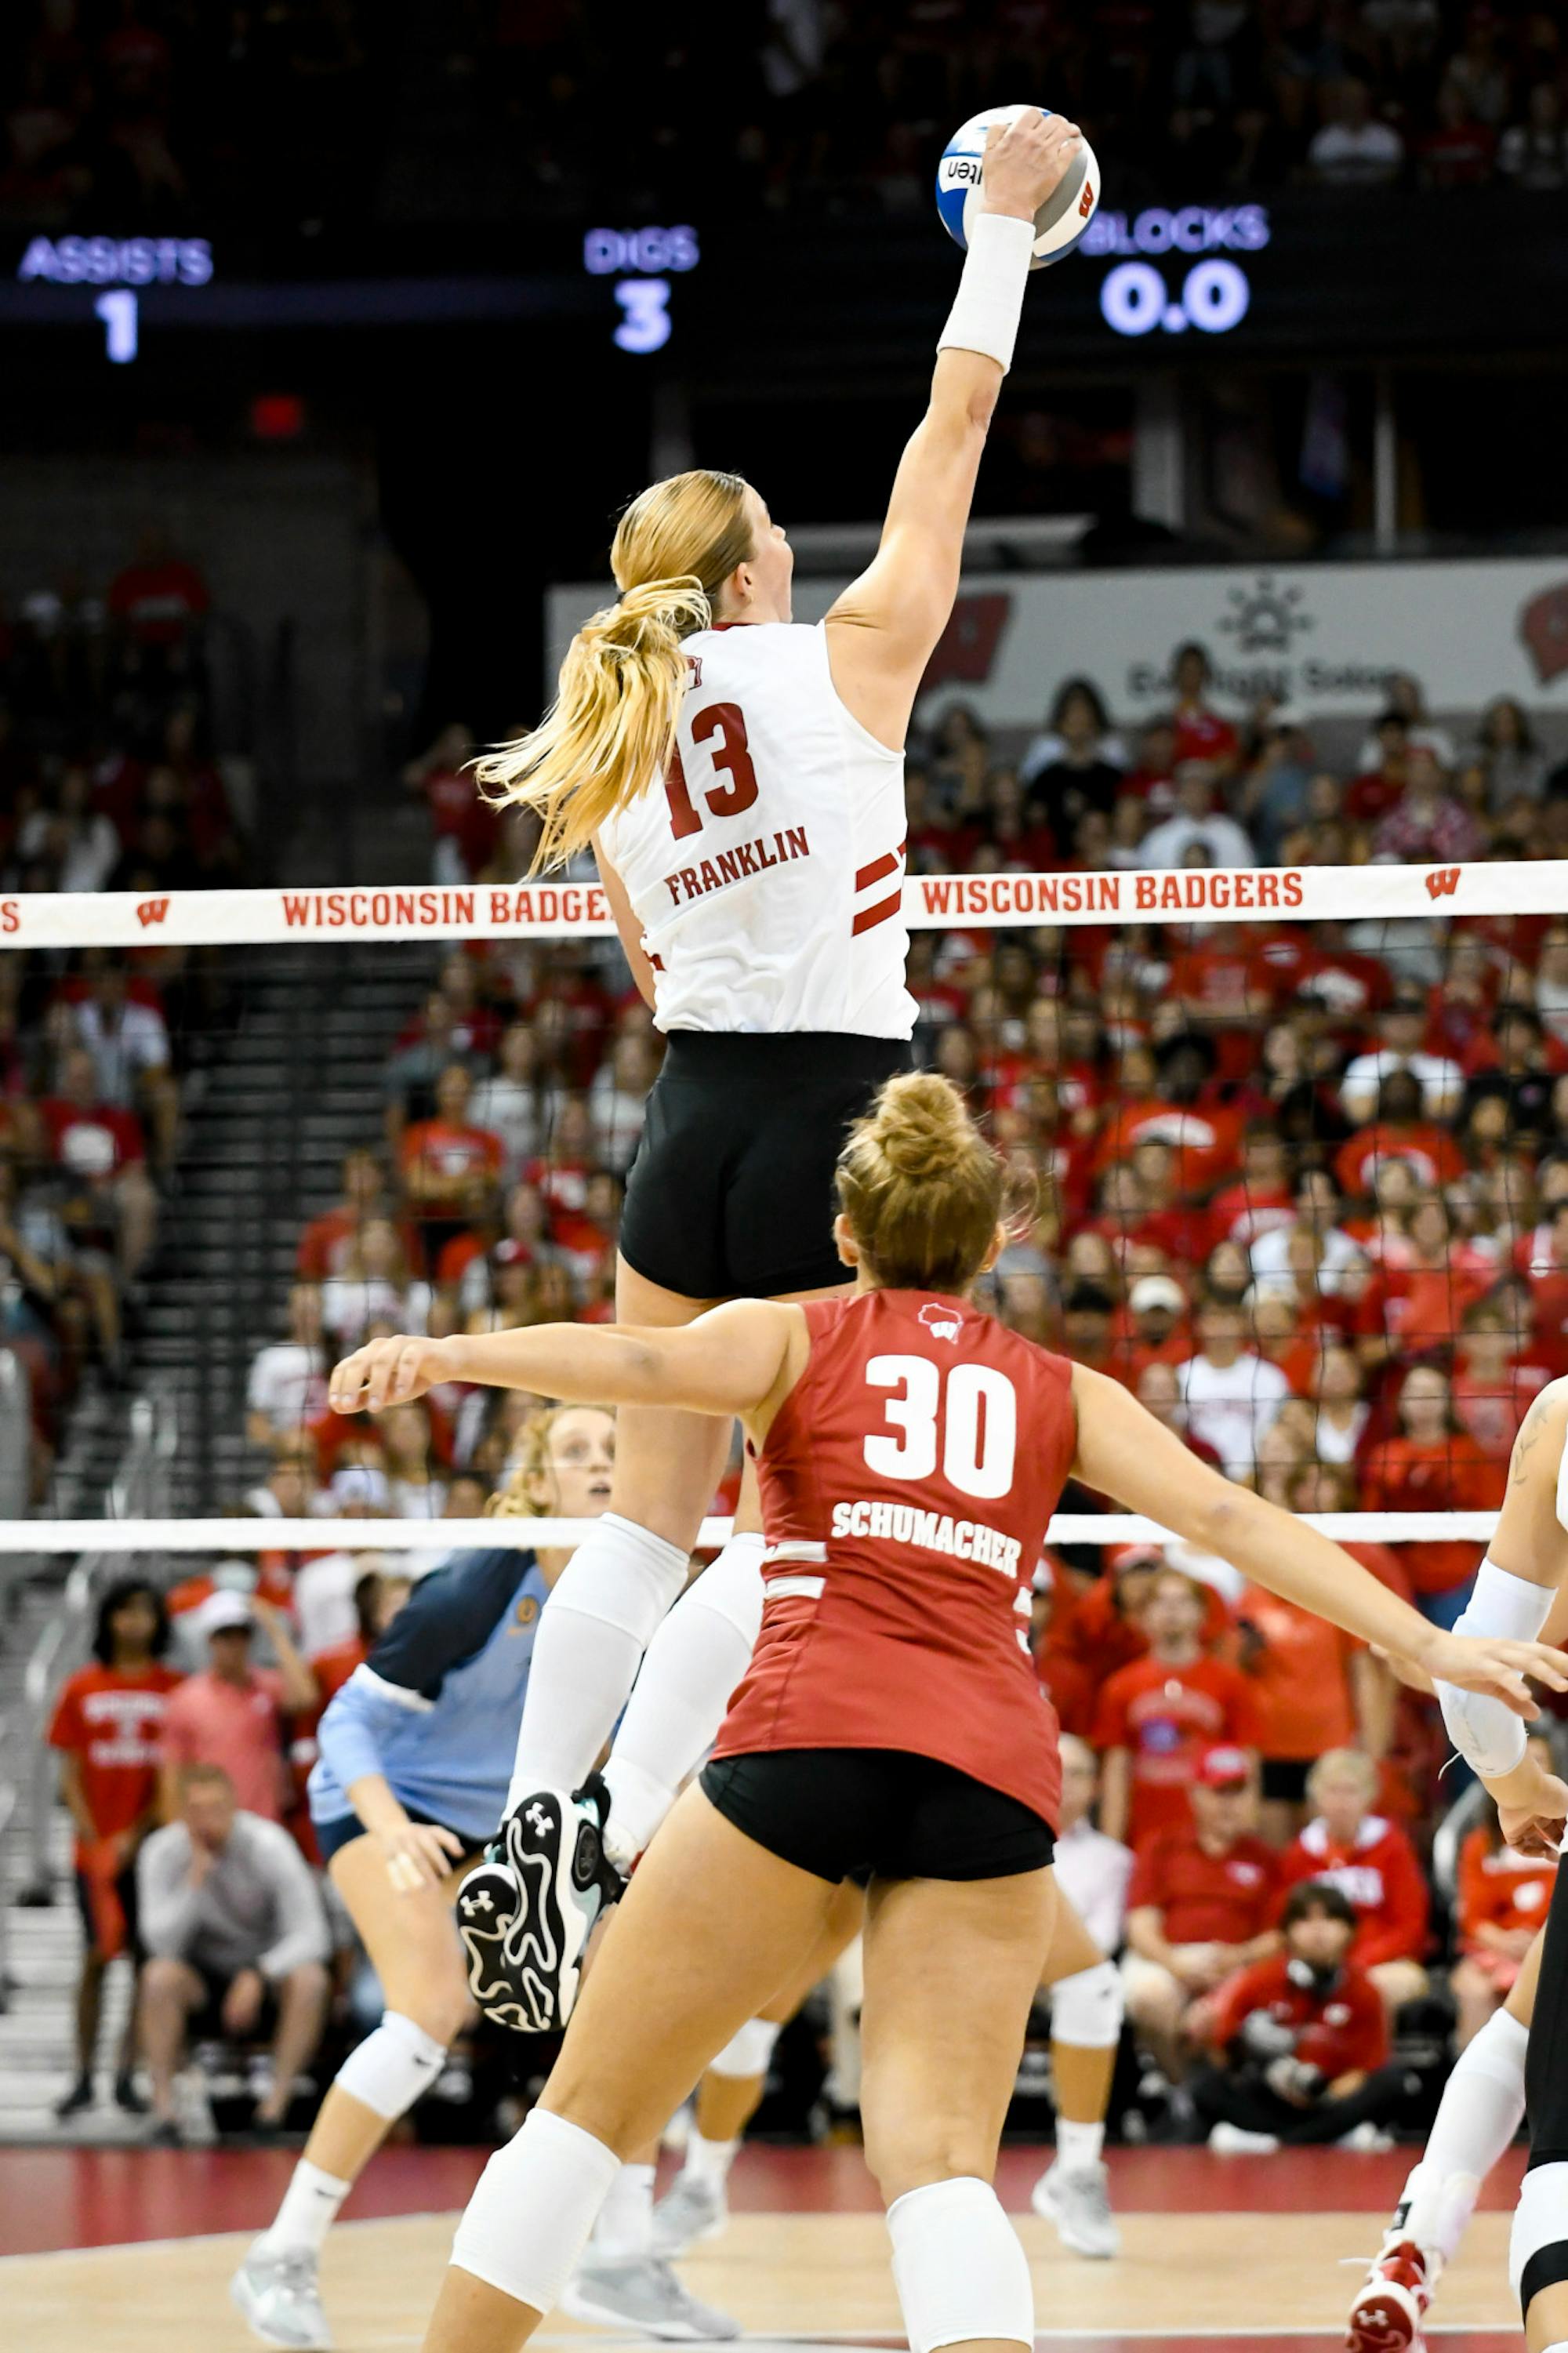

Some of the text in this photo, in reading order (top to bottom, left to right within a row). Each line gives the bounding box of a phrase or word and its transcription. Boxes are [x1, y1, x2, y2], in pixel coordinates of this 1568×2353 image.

[947, 162, 983, 185] lten
[17, 234, 214, 285] ASSISTS
[584, 224, 700, 274] DIGS
[1077, 204, 1269, 256] BLOCKS
[95, 289, 139, 365] 1
[613, 278, 672, 354] 3
[1099, 258, 1250, 336] 0.0
[663, 702, 760, 842] 13
[664, 826, 811, 906] FRANKLIN
[921, 872, 1304, 914] WISCONSIN BADGERS
[282, 888, 616, 927] WISCONSIN BADGE
[863, 1354, 1017, 1499] 30
[831, 1501, 1022, 1579] SCHUMACHER
